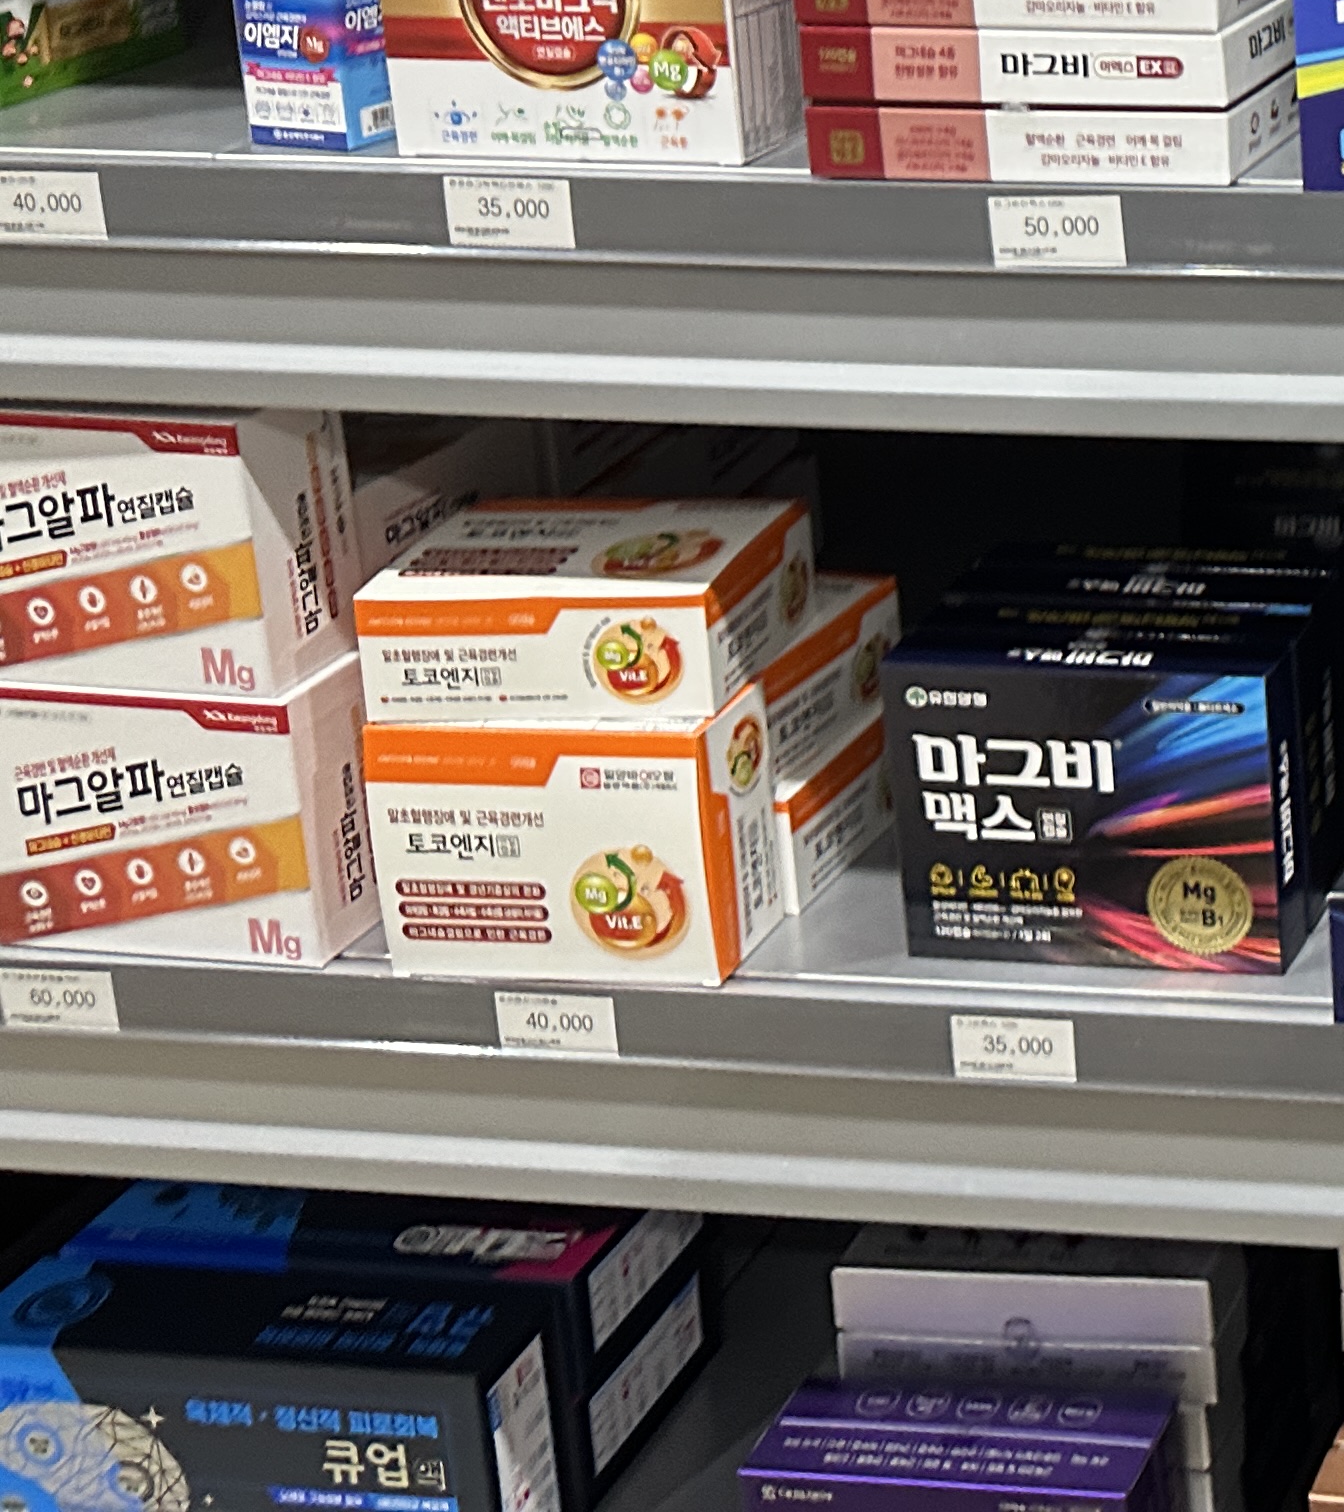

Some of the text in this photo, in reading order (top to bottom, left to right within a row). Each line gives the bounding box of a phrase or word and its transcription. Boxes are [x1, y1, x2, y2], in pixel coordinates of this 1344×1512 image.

[243, 22, 300, 52] 이엠지
[496, 13, 607, 42] 액티브에스
[653, 61, 682, 83] Mg
[1000, 53, 1091, 79] 마그비
[12, 190, 82, 215] 40,000
[477, 198, 551, 221] 35,000
[1023, 215, 1101, 238] 50,000
[0, 483, 195, 548] 그알파 연질캡슐
[199, 647, 257, 692] Mg
[400, 666, 481, 690] 토코엔지
[911, 731, 1117, 794] 마그비
[16, 758, 245, 825] 마그알파 연질캡슐
[922, 790, 1037, 843] 맥스
[404, 832, 497, 861] 토코엔지
[247, 916, 302, 962] Mg
[524, 1011, 595, 1034] 40,000
[982, 1034, 1054, 1057] 35,000
[322, 1439, 410, 1488] 큐업
